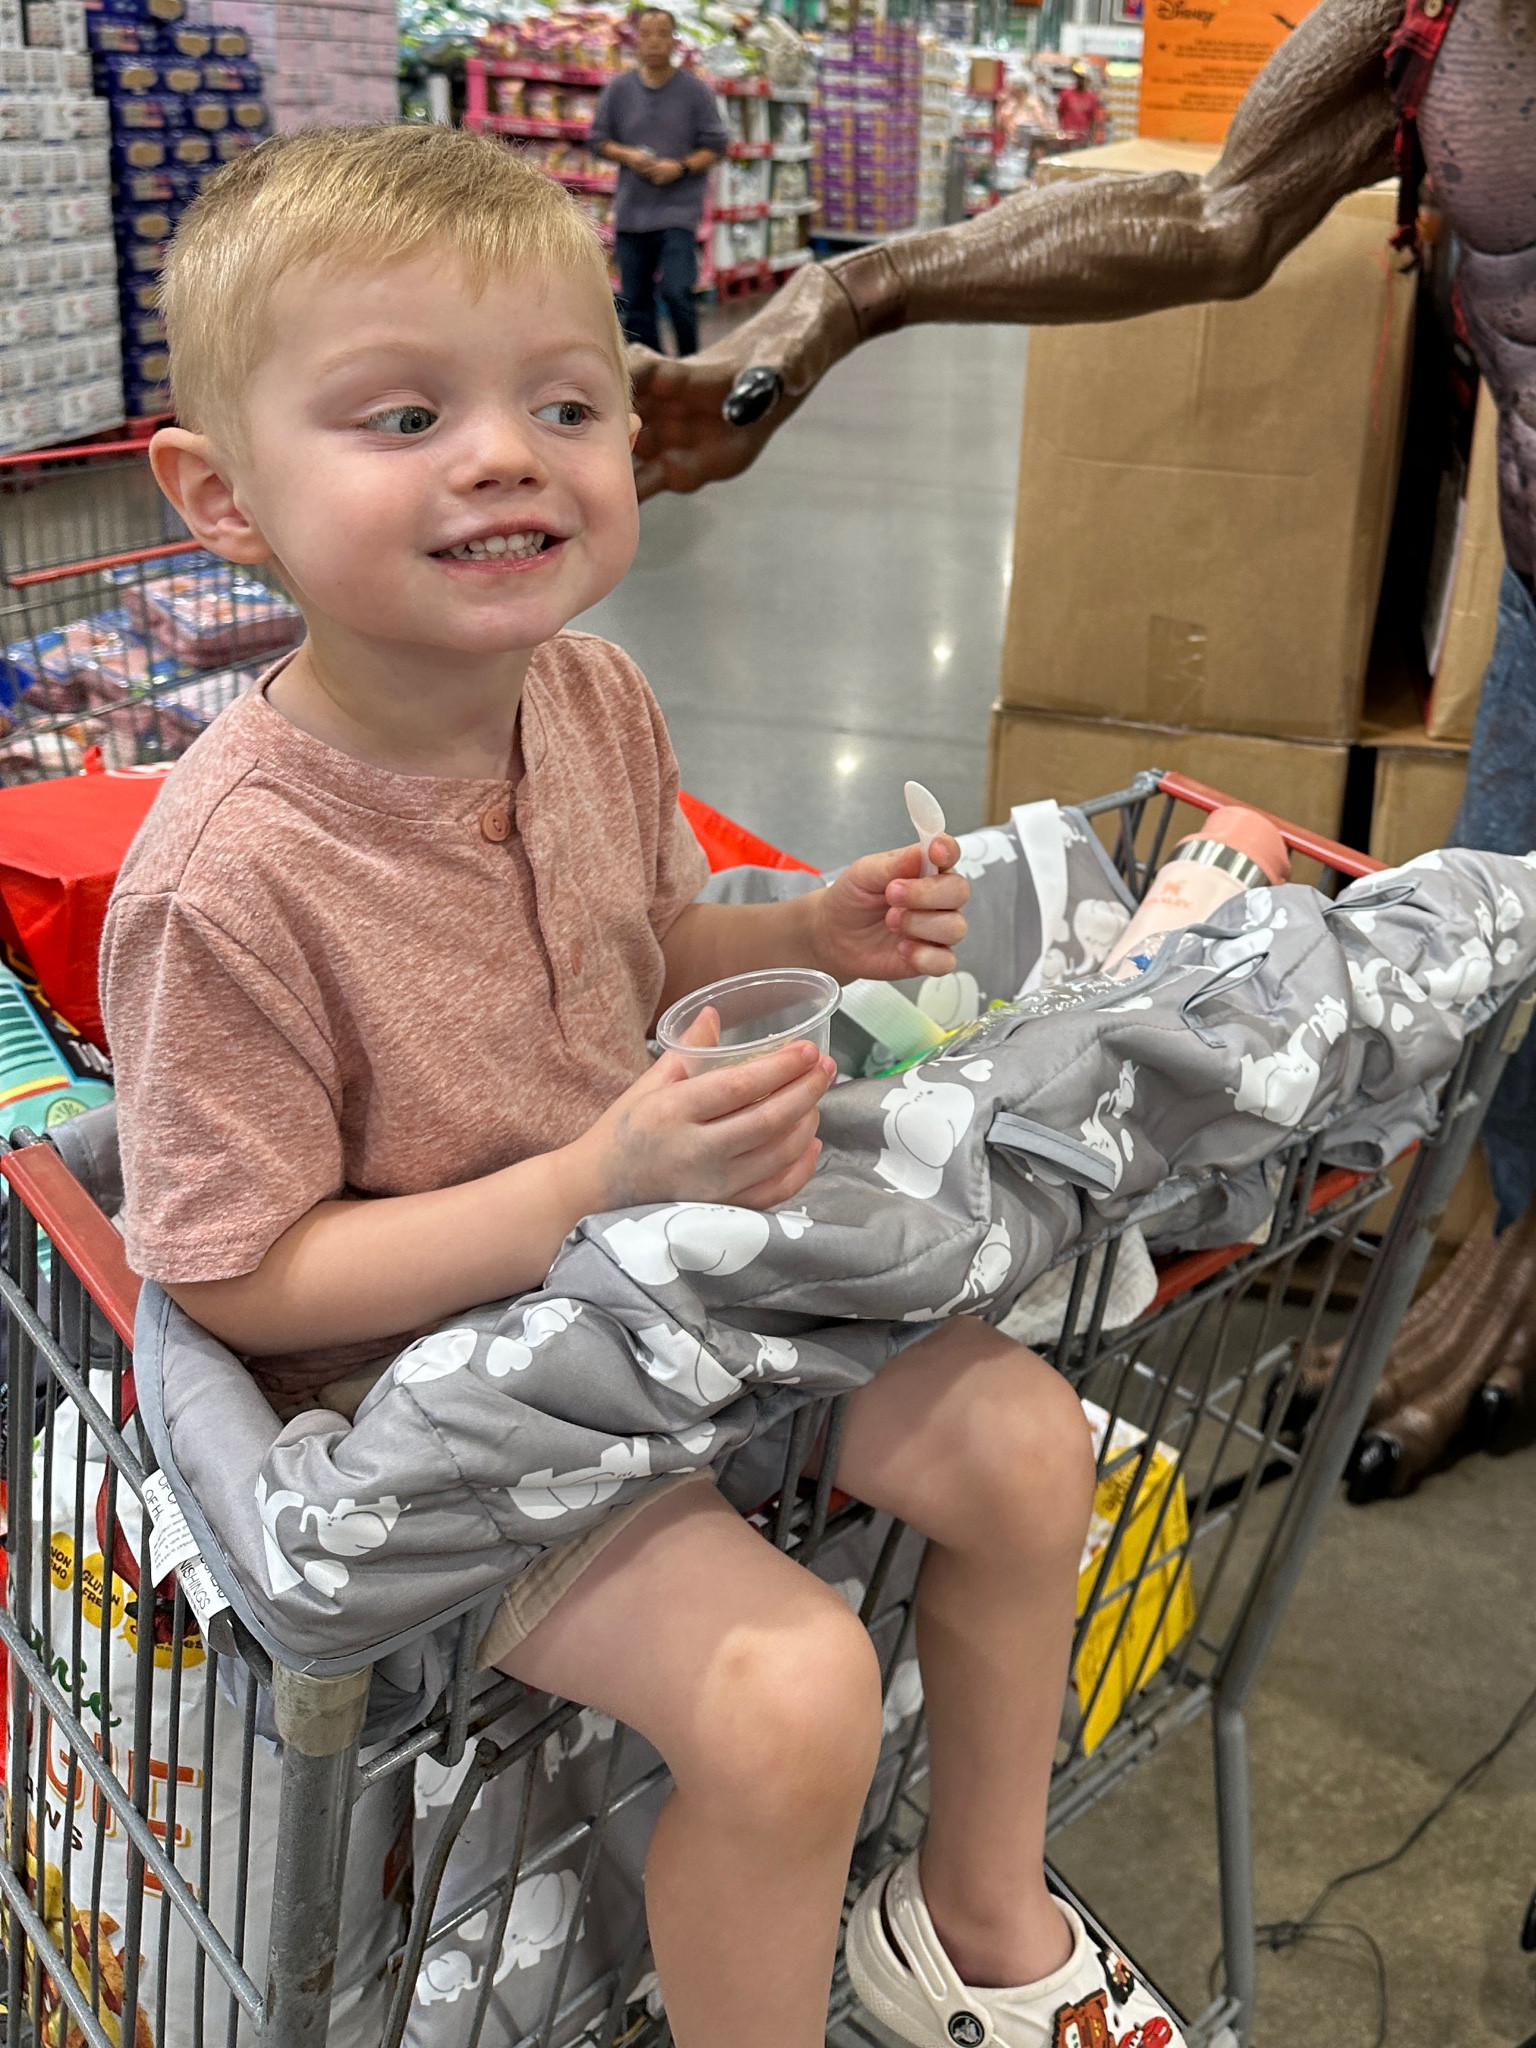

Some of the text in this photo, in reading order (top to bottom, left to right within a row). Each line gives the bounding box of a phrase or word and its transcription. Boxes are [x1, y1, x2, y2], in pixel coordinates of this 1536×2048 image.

[1156, 0, 1216, 28] Disney
[144, 1489, 158, 1505] OF
[50, 1546, 73, 1568] NON
[50, 1562, 68, 1580] MO
[81, 1570, 120, 1607] GLUTN
[81, 1588, 102, 1608] FRE
